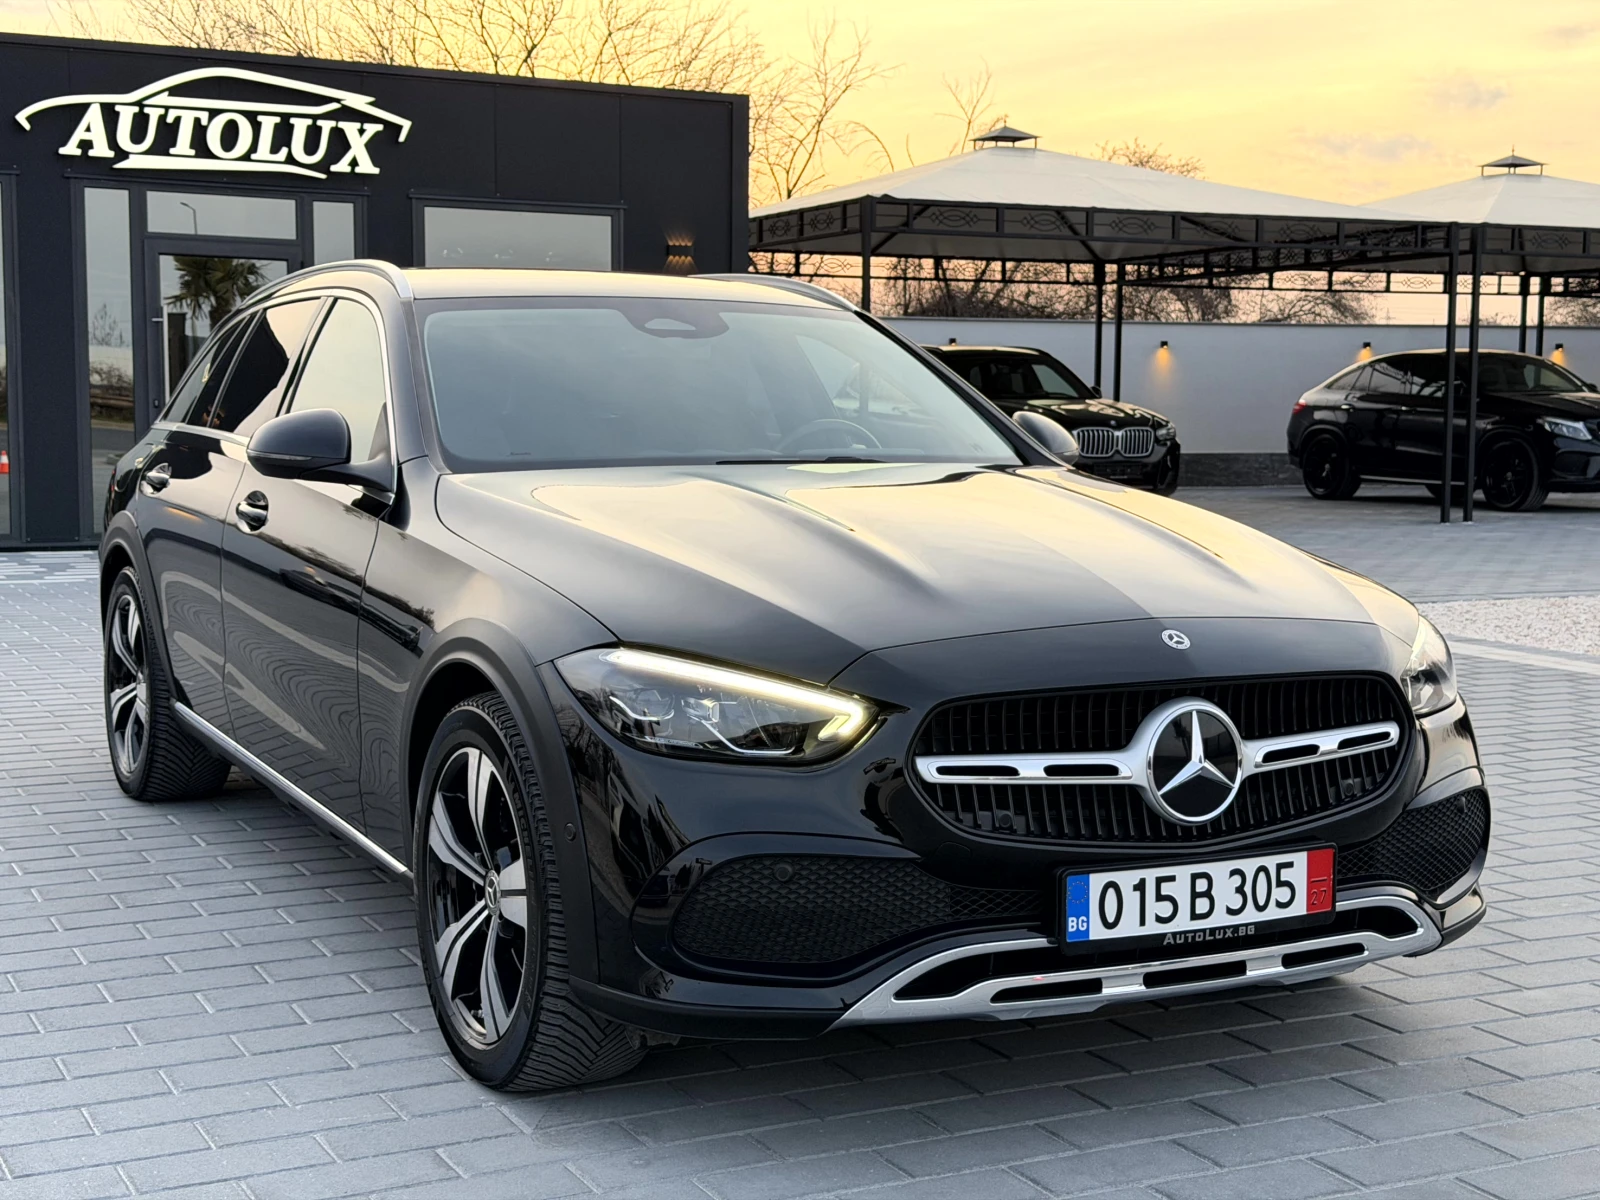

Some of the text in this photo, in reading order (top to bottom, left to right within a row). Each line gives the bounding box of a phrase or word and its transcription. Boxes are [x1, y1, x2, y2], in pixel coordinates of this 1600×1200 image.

[58, 102, 384, 175] AUTOLUX
[1310, 887, 1328, 906] 27
[1068, 916, 1088, 932] BG
